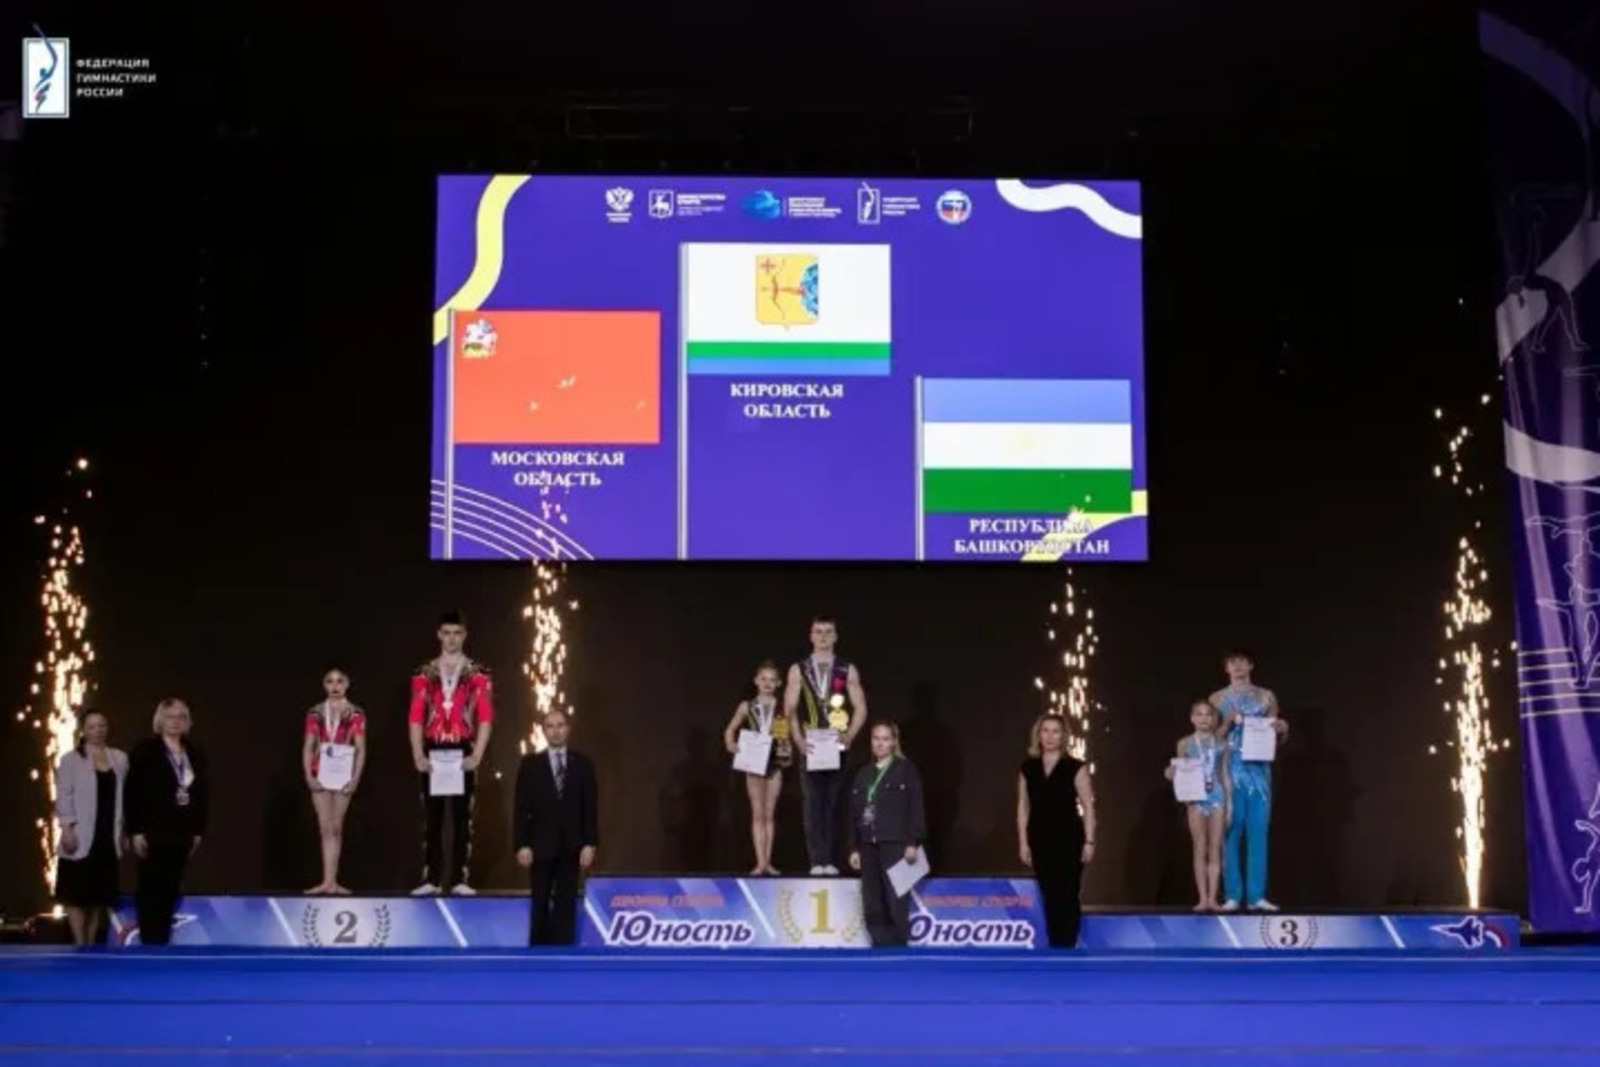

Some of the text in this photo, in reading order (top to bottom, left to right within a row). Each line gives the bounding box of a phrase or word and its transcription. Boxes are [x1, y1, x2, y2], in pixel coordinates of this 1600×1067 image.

[730, 383, 844, 398] КИРОВСКАЯ
[743, 404, 831, 419] ОБЛАСТЬ
[491, 452, 625, 466] МОСКОВСКАЯ
[514, 472, 602, 487] ОБЛАСТЬ
[809, 889, 834, 933] 1
[333, 911, 359, 943] 2
[610, 914, 752, 943] Юность
[1281, 919, 1299, 946] 3
